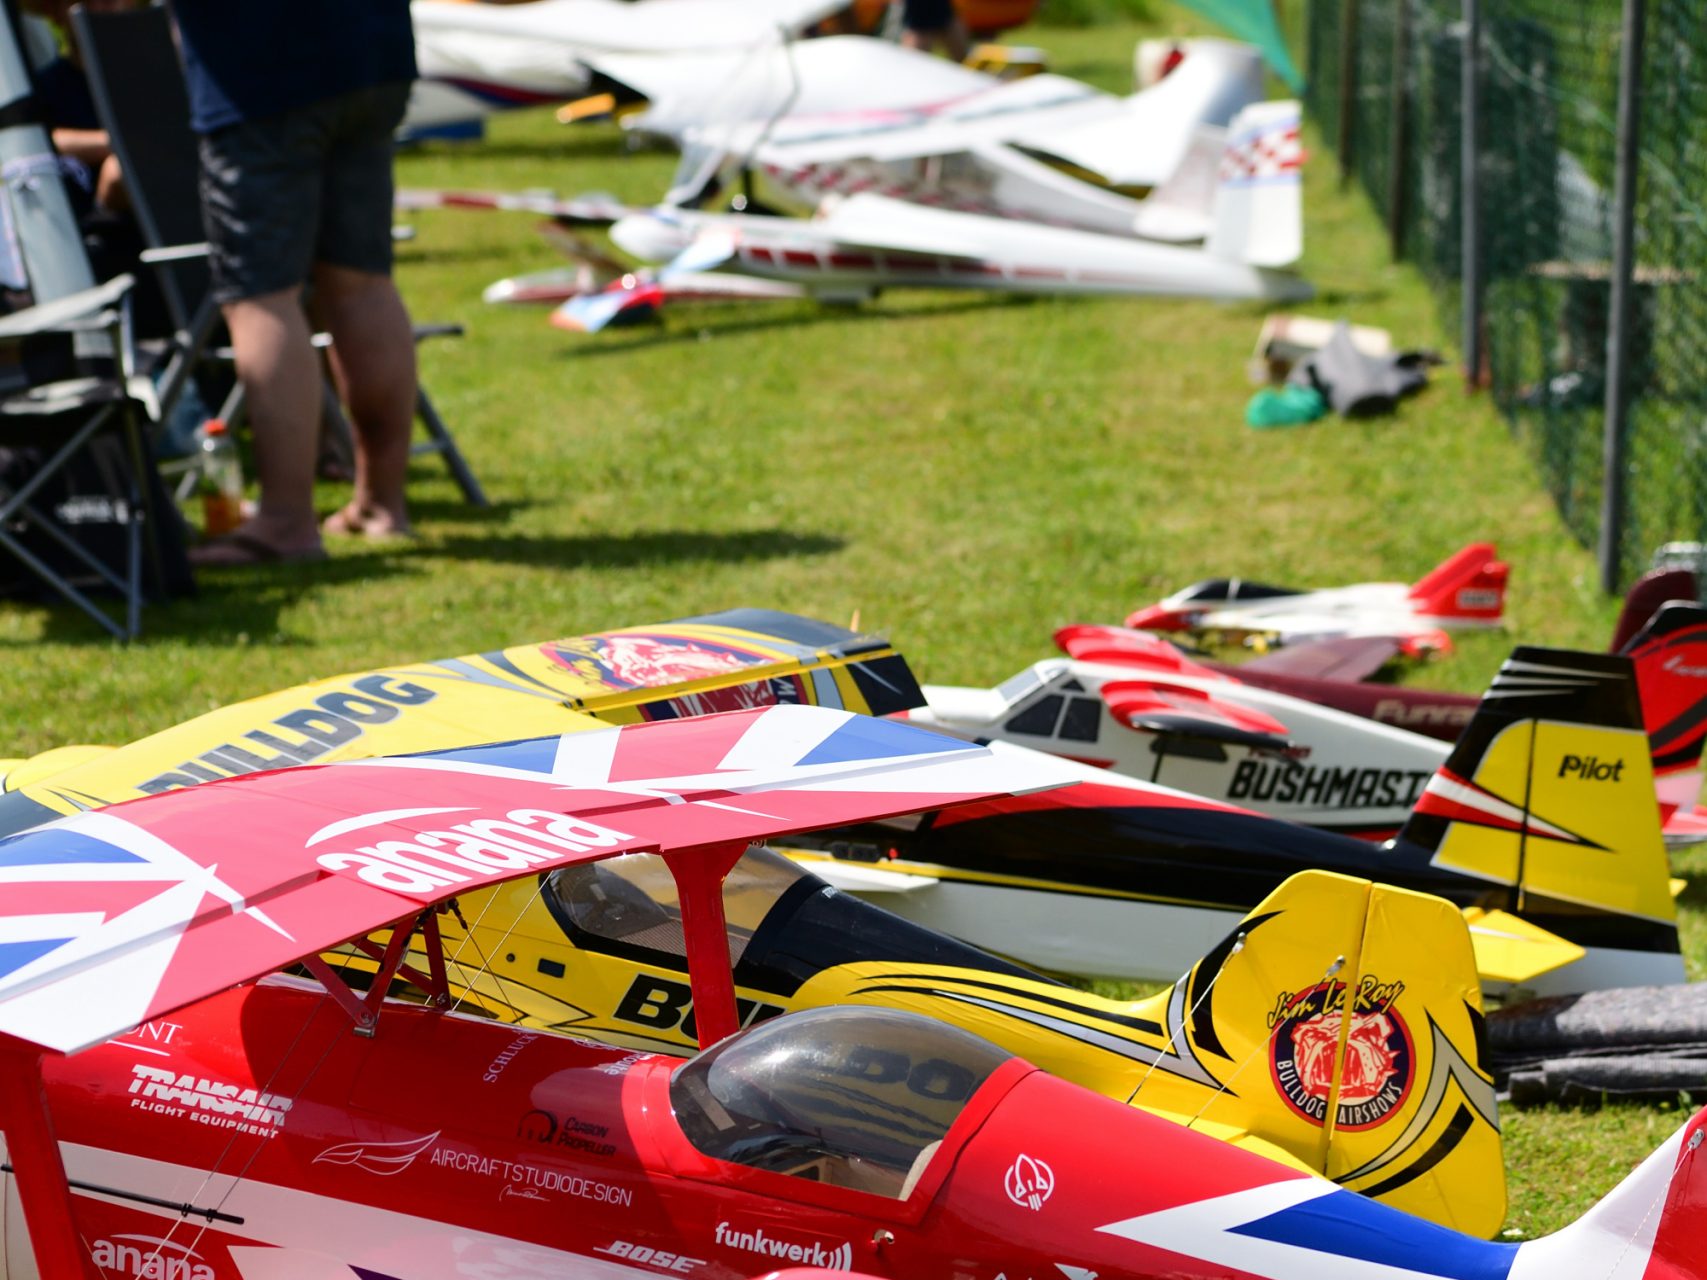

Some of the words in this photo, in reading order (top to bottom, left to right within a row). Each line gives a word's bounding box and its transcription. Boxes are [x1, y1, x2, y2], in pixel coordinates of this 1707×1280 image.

[1227, 760, 1429, 809] BUSHMAST
[1557, 754, 1626, 782] Pilot
[316, 808, 636, 893] anana
[1267, 991, 1316, 1029] Jim
[128, 1064, 293, 1126] TRANSAIR
[1277, 1059, 1327, 1119] BULLDOG
[1338, 1081, 1402, 1125] AIRSHOWS
[131, 1098, 186, 1118] FLIGHT
[190, 1111, 279, 1139] EQUIPMENT
[430, 1144, 632, 1207] AIRCRAFTSTUDIODESIGN
[601, 1240, 702, 1273] BOSE
[714, 1221, 828, 1268] funkwerk
